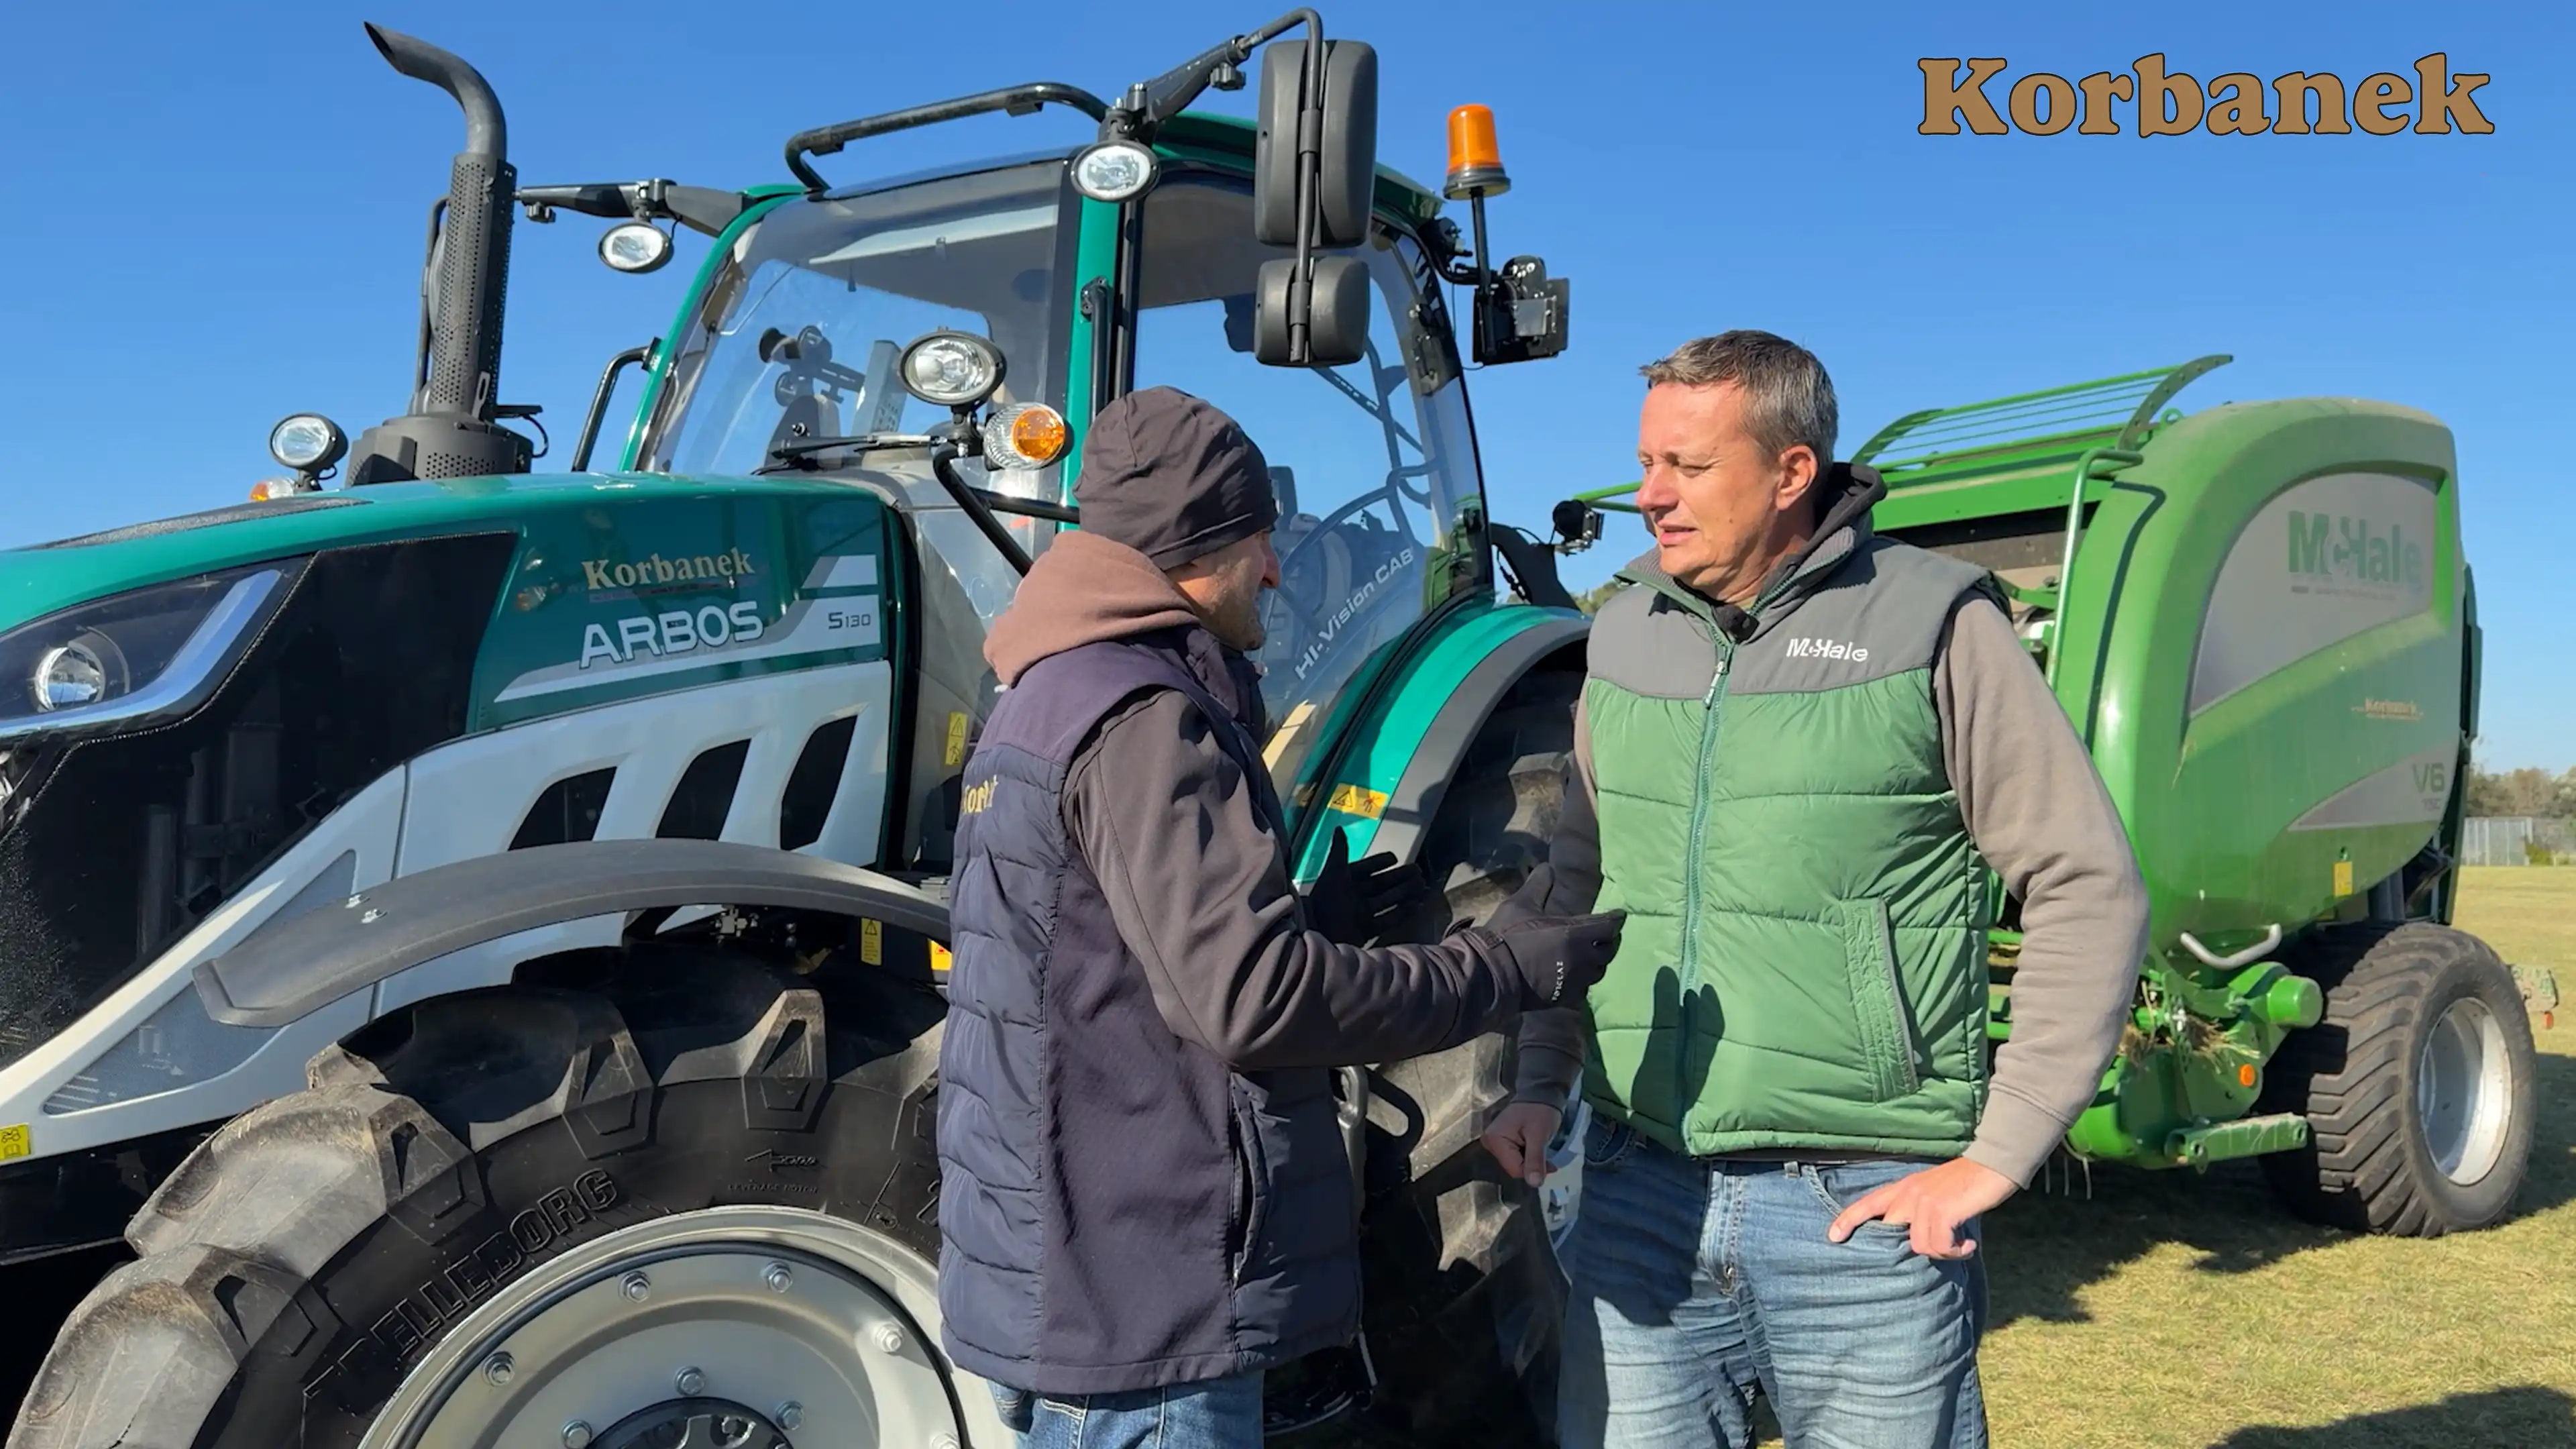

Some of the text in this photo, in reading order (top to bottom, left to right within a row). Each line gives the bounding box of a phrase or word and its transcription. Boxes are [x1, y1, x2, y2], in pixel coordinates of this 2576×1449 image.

[581, 547, 755, 590] Korbanek
[1375, 549, 1414, 584] CAB
[2288, 510, 2424, 584] McHale
[579, 600, 764, 668] ARBOS
[1786, 637, 1869, 663] McHale
[2412, 762, 2445, 793] V6
[303, 1168, 617, 1399] ELLEBORG
